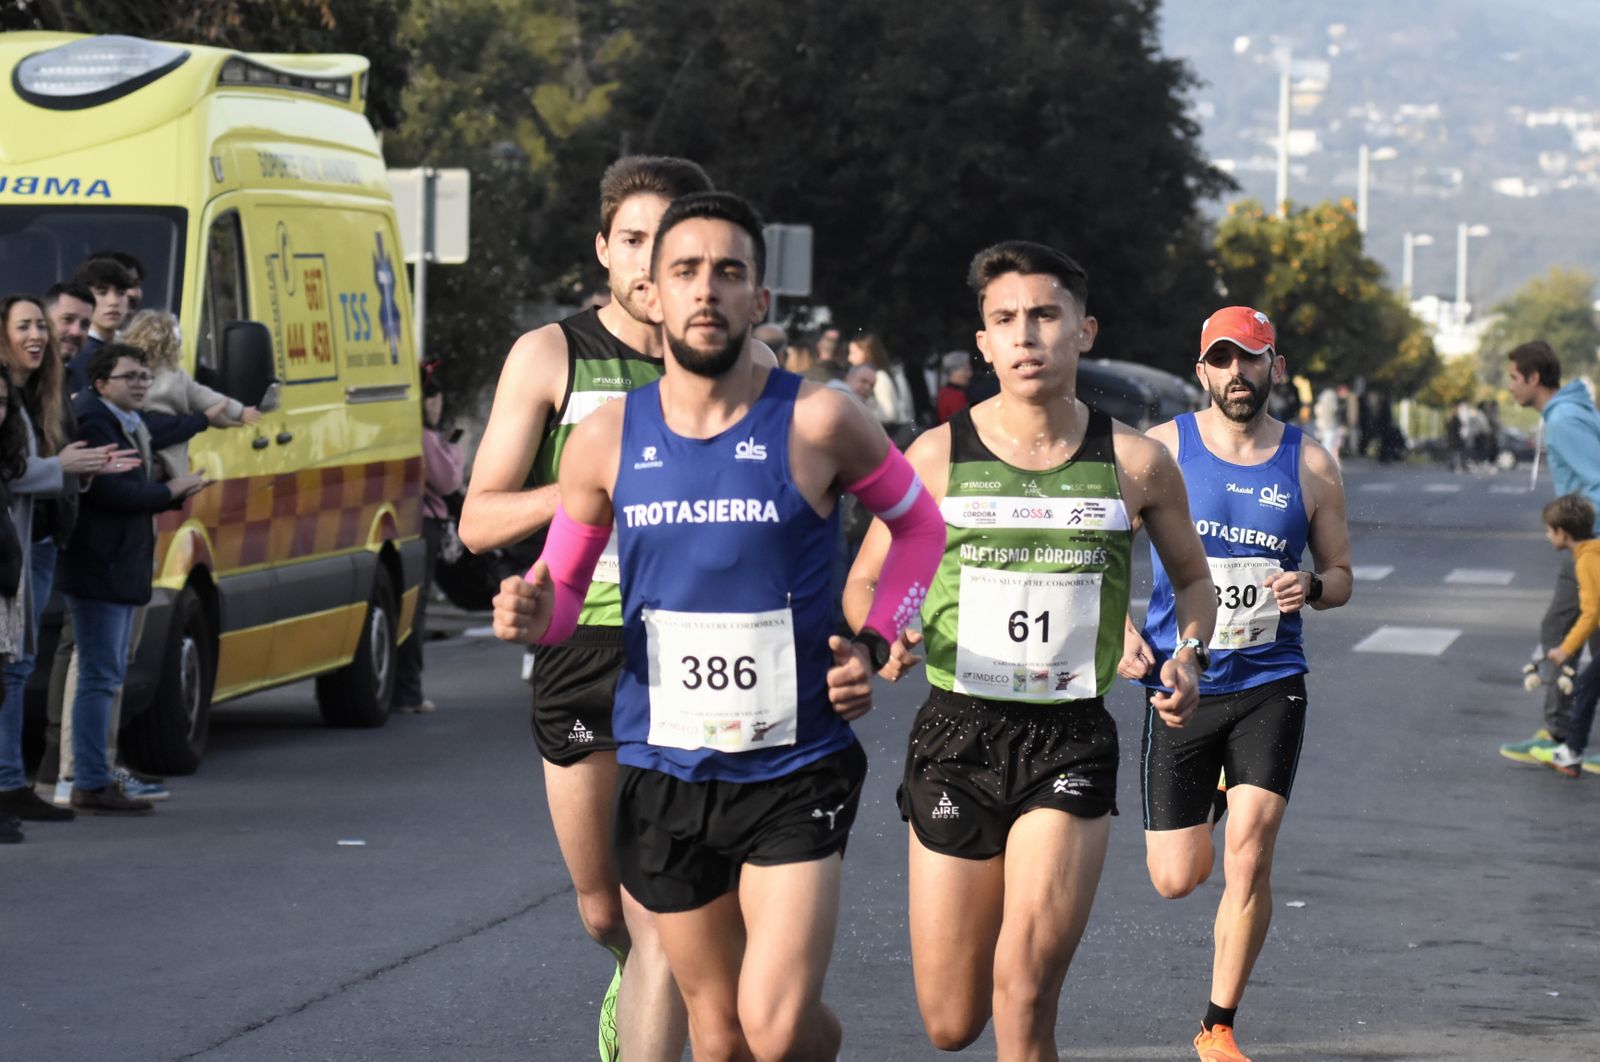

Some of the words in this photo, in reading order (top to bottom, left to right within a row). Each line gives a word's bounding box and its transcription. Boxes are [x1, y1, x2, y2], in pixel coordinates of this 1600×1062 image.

[338, 291, 371, 342] TSS
[623, 499, 780, 528] TROTASIERRA
[1192, 519, 1288, 552] OTASIERRA
[960, 543, 1029, 562] ATLETISMO
[1008, 610, 1050, 643] 61
[681, 655, 757, 690] 386
[973, 672, 1010, 684] IMDECO
[568, 731, 594, 739] AIRE
[932, 806, 960, 815] AIRE
